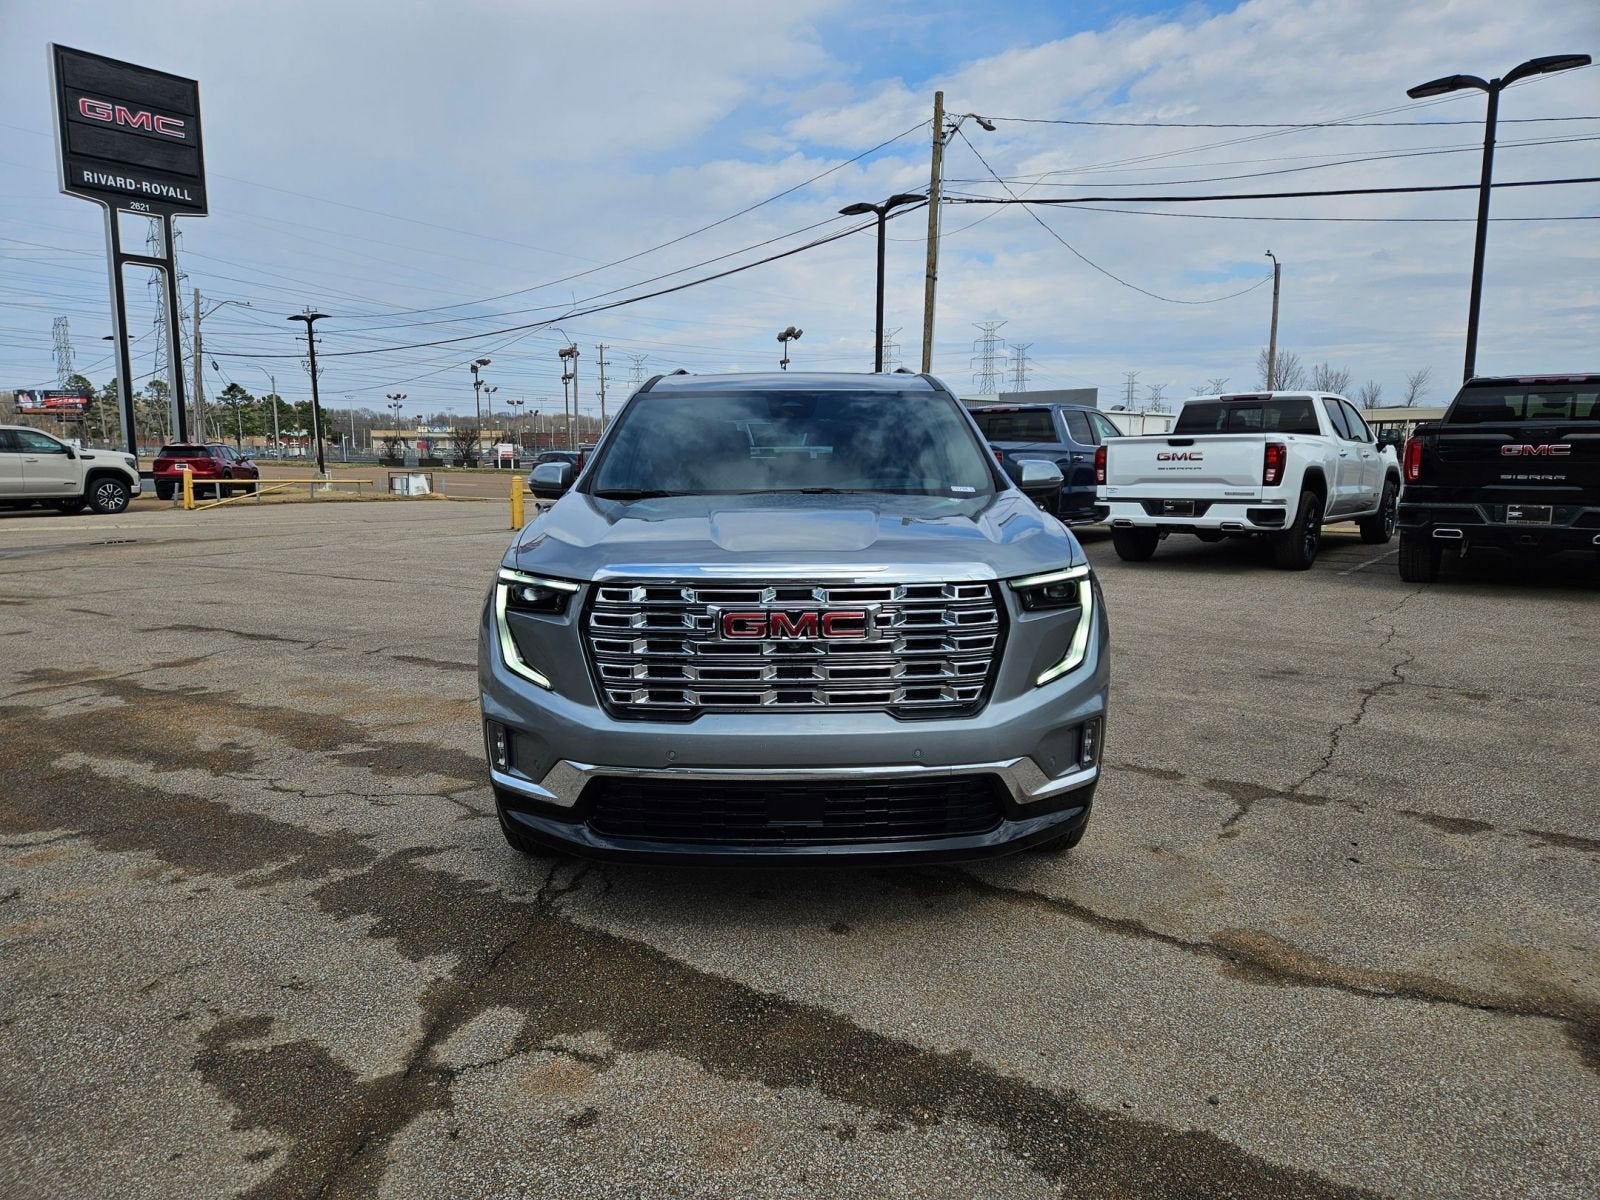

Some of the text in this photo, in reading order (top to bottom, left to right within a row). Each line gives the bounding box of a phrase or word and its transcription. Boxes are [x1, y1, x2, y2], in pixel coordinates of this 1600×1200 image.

[79, 98, 185, 138] GMC
[83, 171, 192, 201] RIVARD-ROYALL
[130, 201, 150, 212] 2621
[1157, 452, 1203, 461] GMC
[1501, 444, 1571, 456] GMC
[723, 612, 866, 639] GMC
